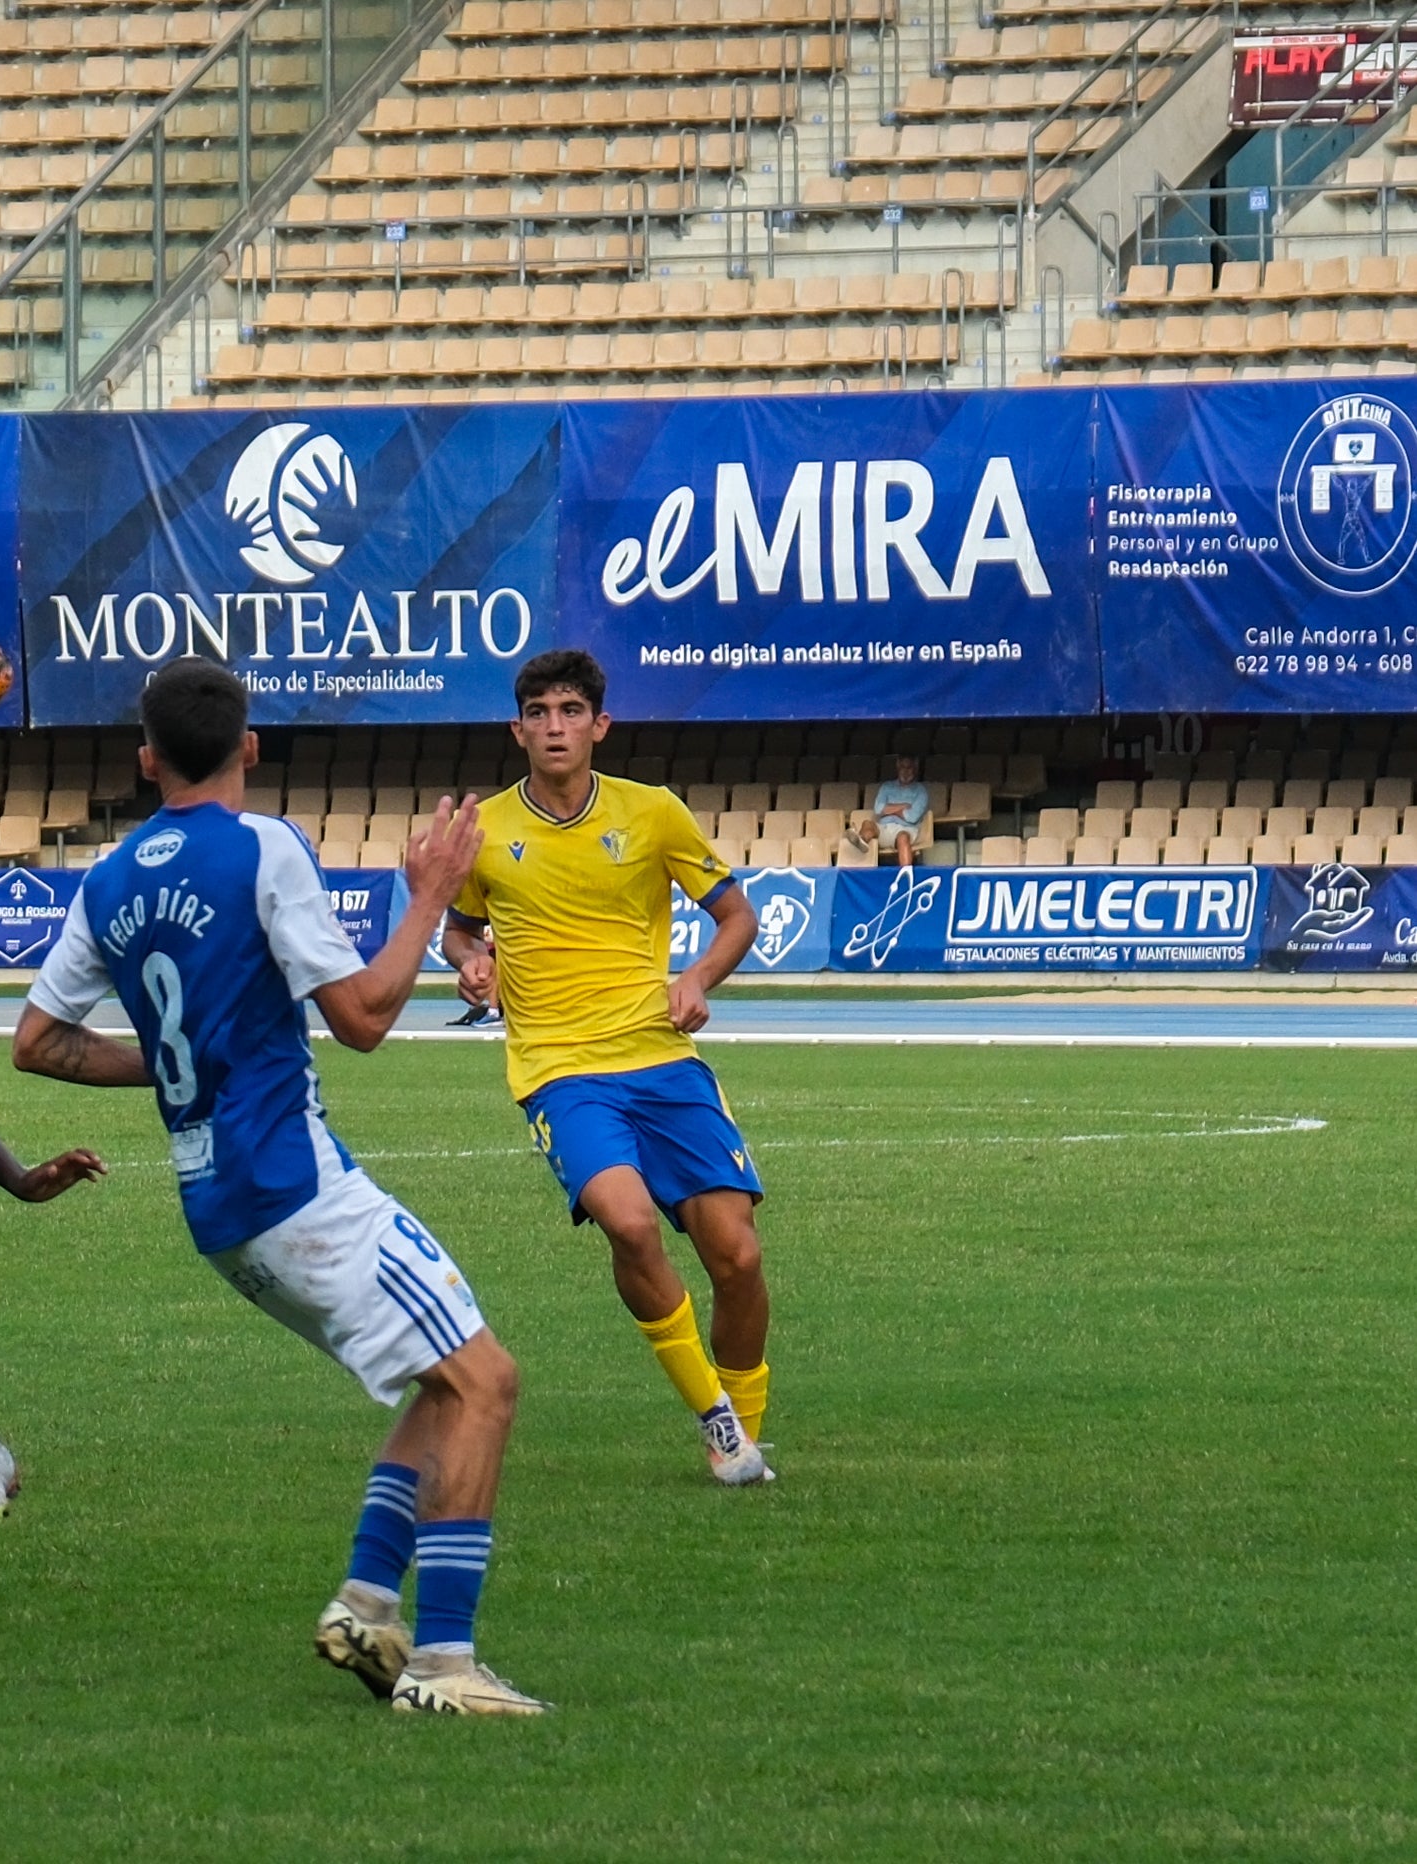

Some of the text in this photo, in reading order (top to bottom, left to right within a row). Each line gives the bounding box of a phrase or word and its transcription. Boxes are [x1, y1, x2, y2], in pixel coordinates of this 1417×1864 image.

[1108, 484, 1212, 504] Fisioterapia
[1107, 509, 1238, 526] Entrenamiento
[1108, 534, 1279, 554] Personal y en Grupo
[1109, 559, 1229, 578] Readaptación
[49, 587, 531, 662] MONTEALTO
[1246, 626, 1294, 644] Calle
[1301, 626, 1378, 644] Andorra
[640, 639, 1022, 669] Medio digital andaluz líder en España
[1236, 655, 1269, 673] 622
[1275, 655, 1299, 672] 78
[1306, 655, 1329, 672] 98
[1335, 654, 1358, 672] 94
[1379, 654, 1413, 672] 608
[285, 670, 308, 692] de
[313, 668, 445, 697] Especialidades
[138, 841, 179, 858] LUGO
[342, 889, 370, 911] 677
[957, 879, 1250, 931] JMELECTRI
[103, 878, 216, 958] IAGO DÍAZ
[670, 920, 701, 954] 21
[761, 934, 782, 954] 21
[944, 943, 1246, 962] INSTALACIONES ELÉCTRICAS Y MANTENIMIENTOS
[142, 951, 197, 1106] 8
[394, 1212, 441, 1262] 8
